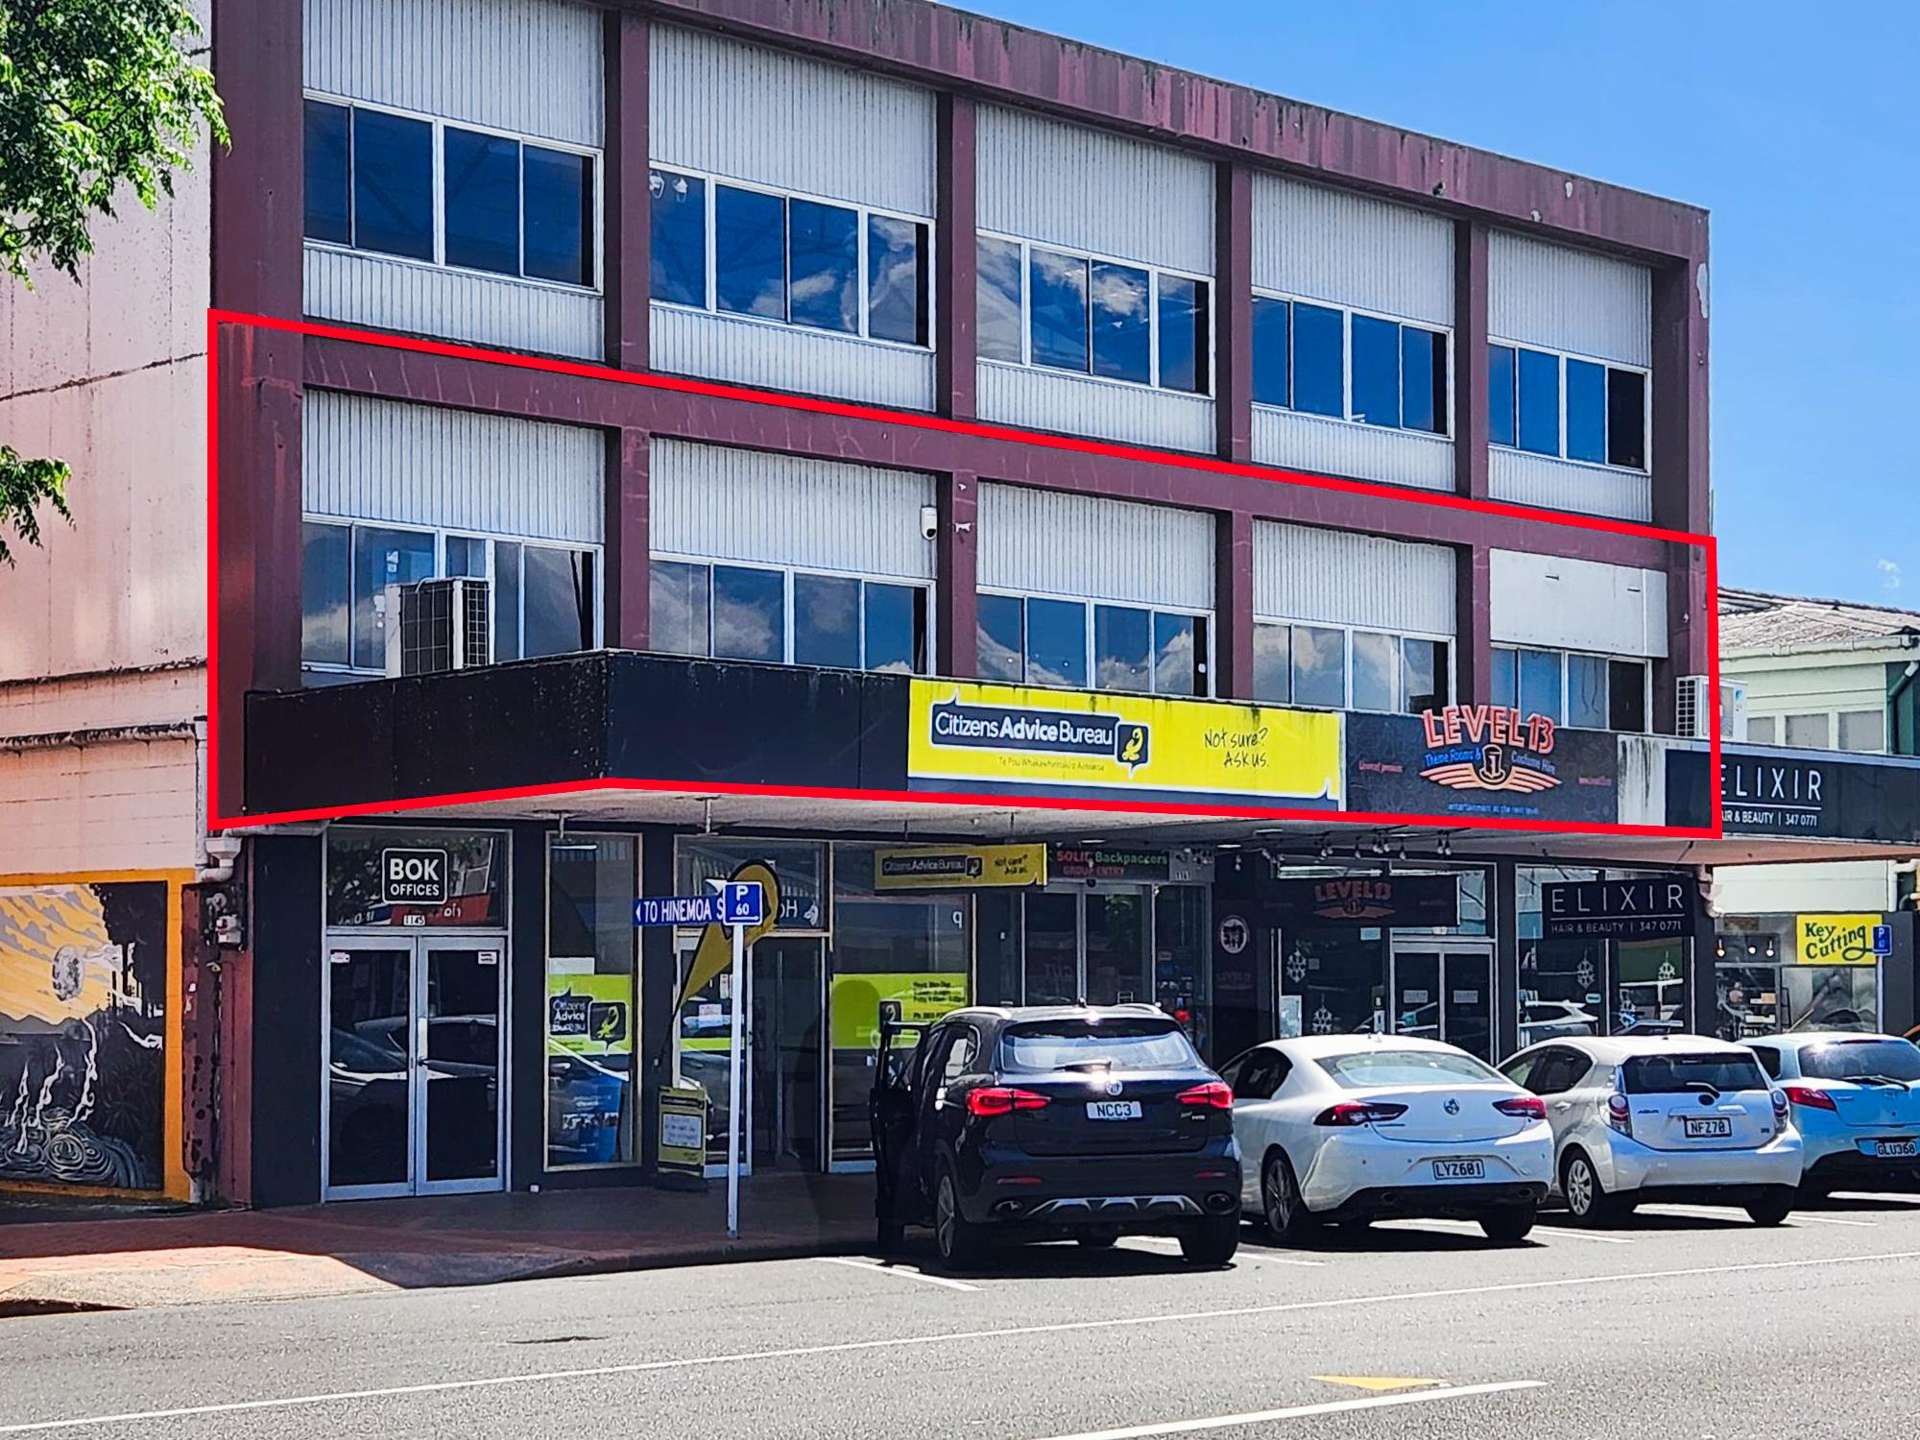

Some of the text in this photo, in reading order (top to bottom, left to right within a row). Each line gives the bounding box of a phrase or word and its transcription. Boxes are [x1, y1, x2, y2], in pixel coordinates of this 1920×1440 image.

[935, 711, 1113, 746] Citizens Advice Bureau
[1204, 727, 1269, 749] Not sure?
[1423, 704, 1555, 755] LEVEL 13
[1742, 810, 1775, 824] BEAUTY
[1785, 812, 1799, 826] 347
[1800, 814, 1818, 827] 0771
[389, 858, 440, 881] BOK
[389, 883, 440, 896] OFFICES
[736, 885, 749, 901] P
[1552, 883, 1684, 913] ELIXIR
[643, 898, 723, 922] TO HINEMOA S
[735, 902, 750, 916] 60
[1552, 924, 1575, 934] HAIR
[1586, 922, 1624, 933] BEAUTY
[1639, 921, 1657, 932] 347
[1659, 920, 1682, 931] 0771
[1804, 922, 1837, 944] Key
[1878, 927, 1885, 936] P
[1805, 925, 1873, 961] Cutting
[554, 1008, 586, 1021] Advice
[1096, 1103, 1132, 1117] NCC3
